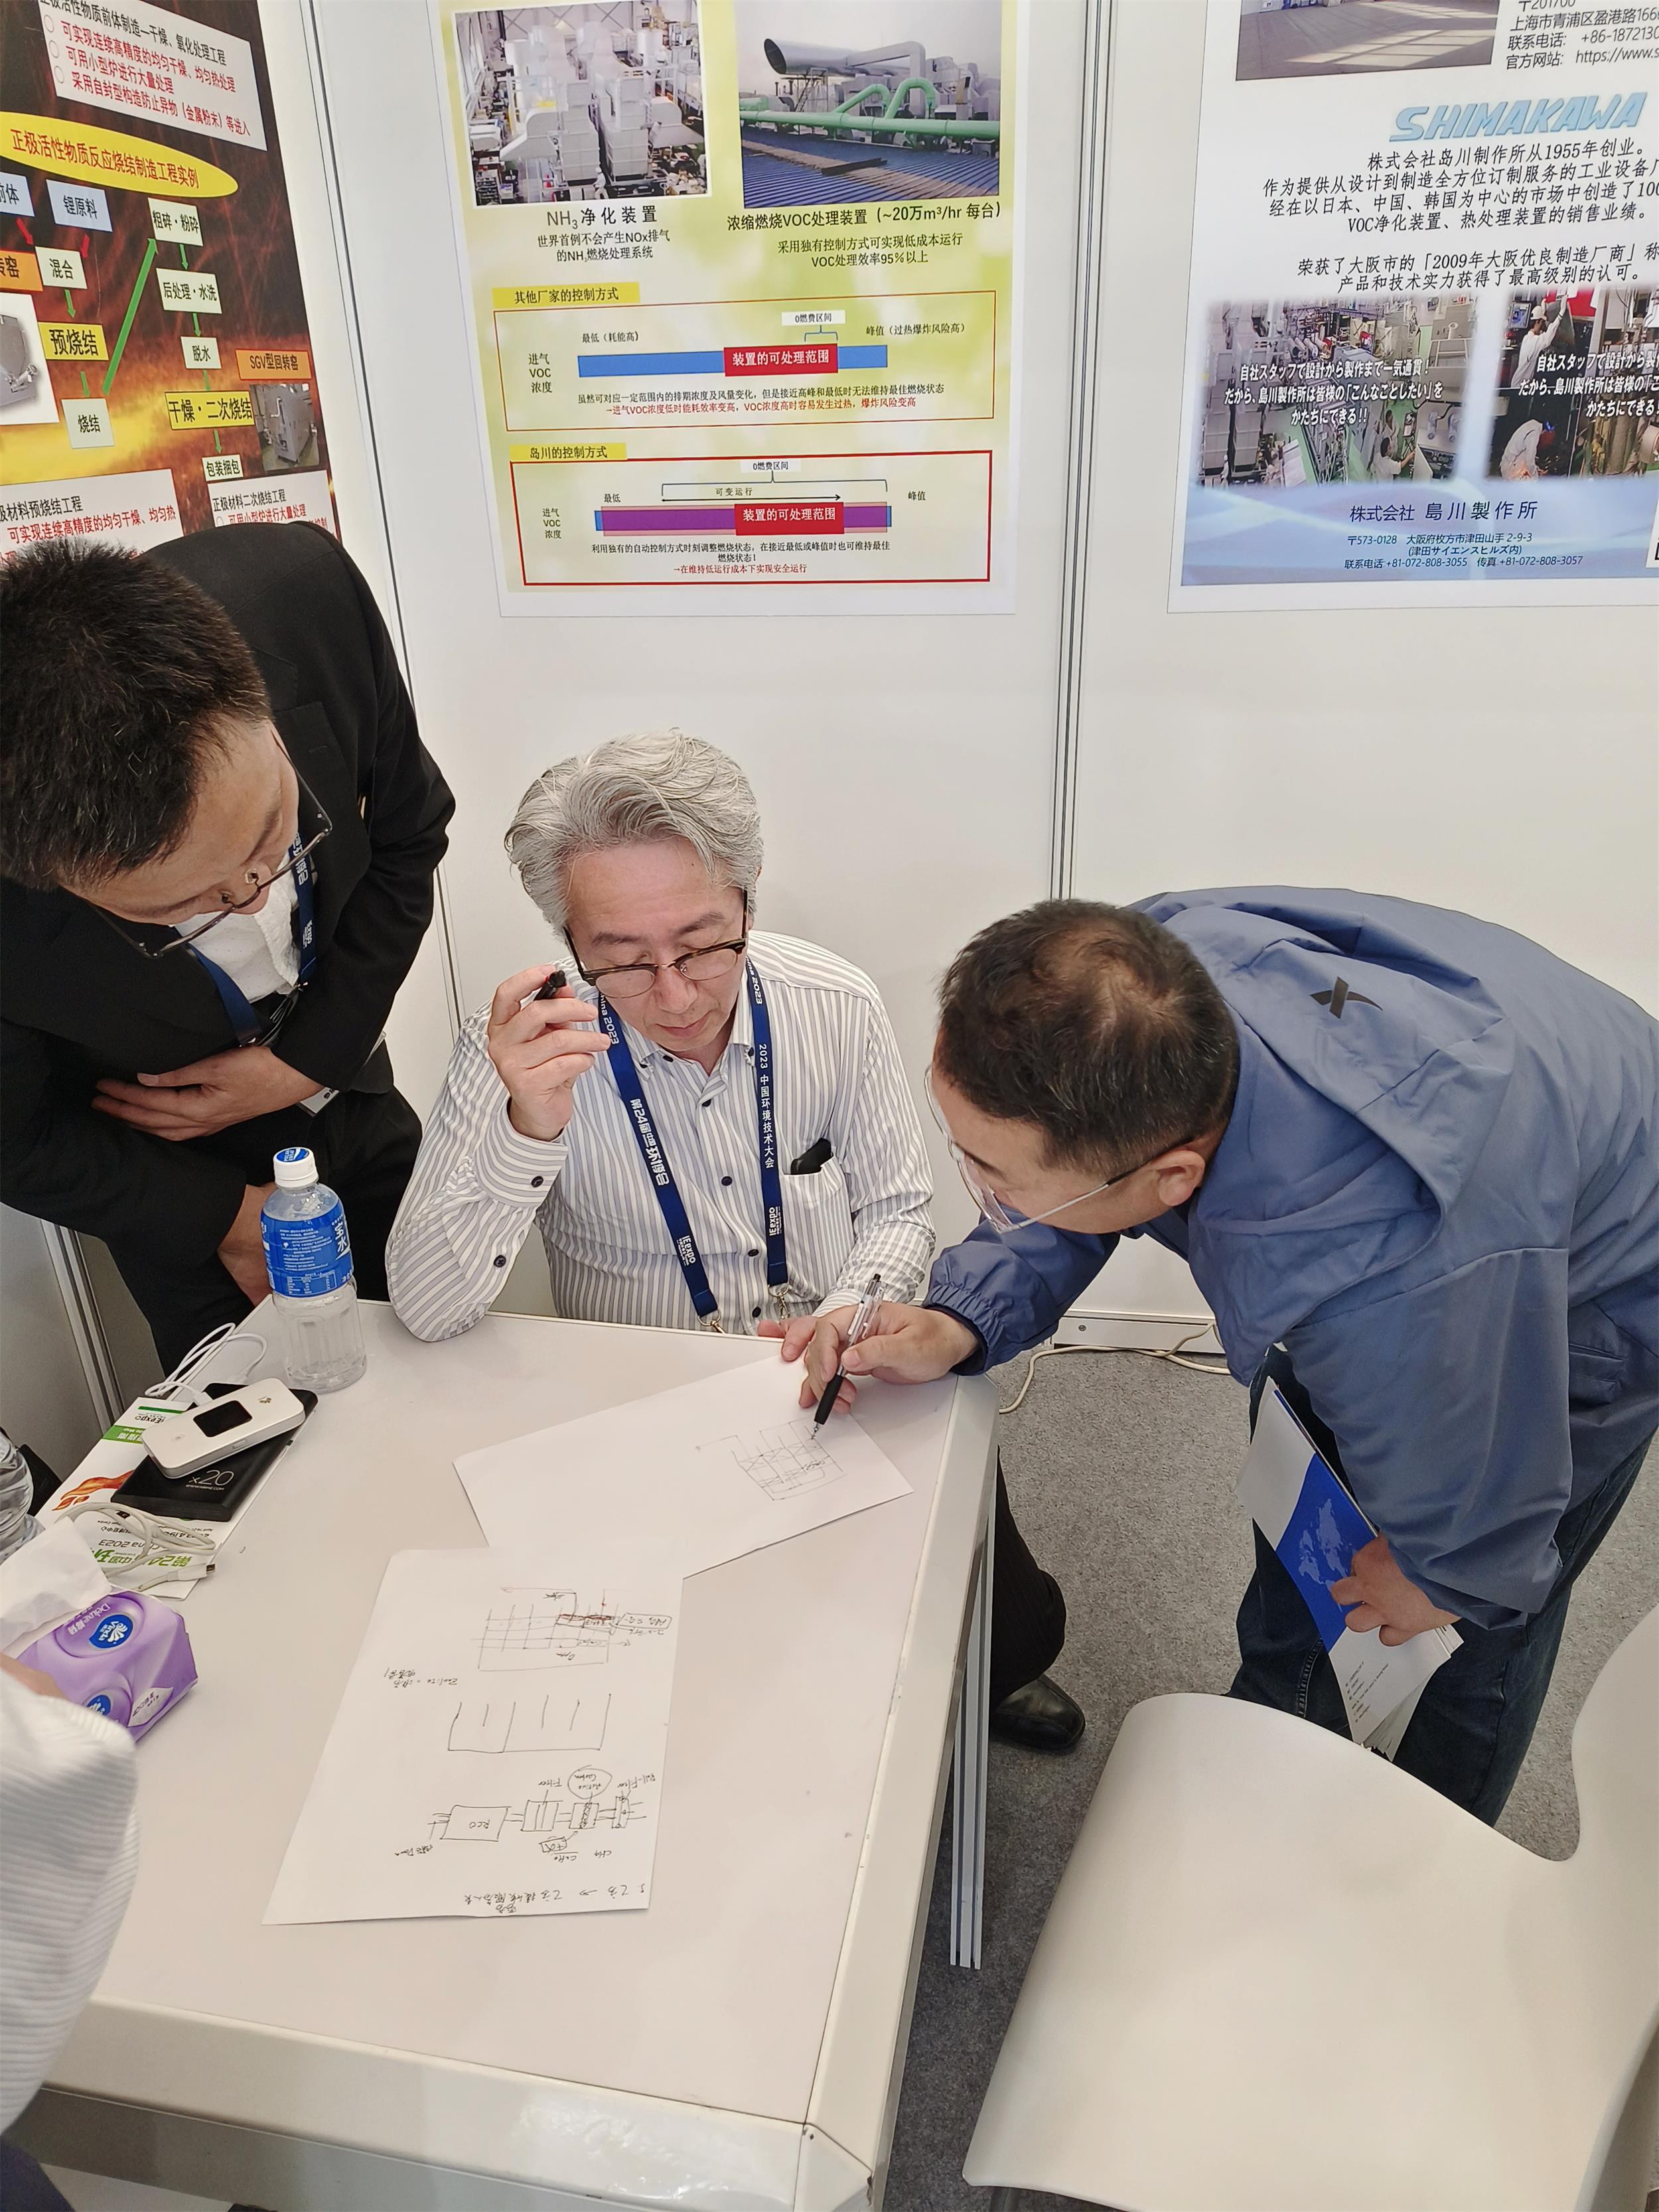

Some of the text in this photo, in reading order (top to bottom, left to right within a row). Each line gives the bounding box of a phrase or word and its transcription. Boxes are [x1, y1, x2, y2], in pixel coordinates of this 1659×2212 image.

[1510, 7, 1659, 31] 上海市青浦区盈港路166
[1390, 92, 1648, 142] SHIMAKAWA
[10, 129, 199, 189] 正极活性物质反应烧结制造工程实例
[63, 195, 98, 220] 锂原料
[727, 208, 867, 232] 浓缩燃烧VOC处理装置
[537, 229, 671, 248] 世界首例不会产生NOx排气
[777, 232, 964, 254] 采用独有控制方式可实现低成本运行
[810, 250, 929, 267] VOC处理效率95%以上
[49, 258, 74, 280] 混合
[514, 287, 619, 304] 其他厂家的控制方式
[50, 329, 99, 356] 预烧结
[192, 344, 211, 362] 脱水
[528, 352, 550, 366] 进气
[732, 349, 830, 366] 装置的可处理范围
[1537, 350, 1659, 373] 自社スタッフで設計から製
[250, 354, 299, 372] SGV型回转窑
[529, 368, 551, 378] VOC
[531, 381, 553, 394] 浓度
[77, 414, 101, 434] 烧结
[530, 446, 608, 459] 岛川的控制方式
[206, 459, 241, 477] 包装捆包
[212, 488, 287, 512] 正极材料二次烧结工程
[604, 493, 621, 504] 最低
[715, 487, 753, 496] 可变运行
[908, 490, 926, 501] 峰值
[542, 508, 560, 518] 进气
[743, 507, 836, 522] 装置的可处理范围
[1349, 500, 1538, 522] 株式会社 島川製作所
[543, 519, 561, 528] VOC
[545, 530, 562, 539] 浓度
[1406, 533, 1504, 545] 大阪府枚方市津田山手
[1506, 532, 1532, 542] 2-9-3
[1344, 555, 1583, 569] 联系电话 +81-072-808-3055 传真 +81-072-808-3057
[752, 977, 763, 1005] 2023
[603, 1015, 620, 1045] 2023
[758, 1043, 775, 1169] 2023 中国环境技术大会
